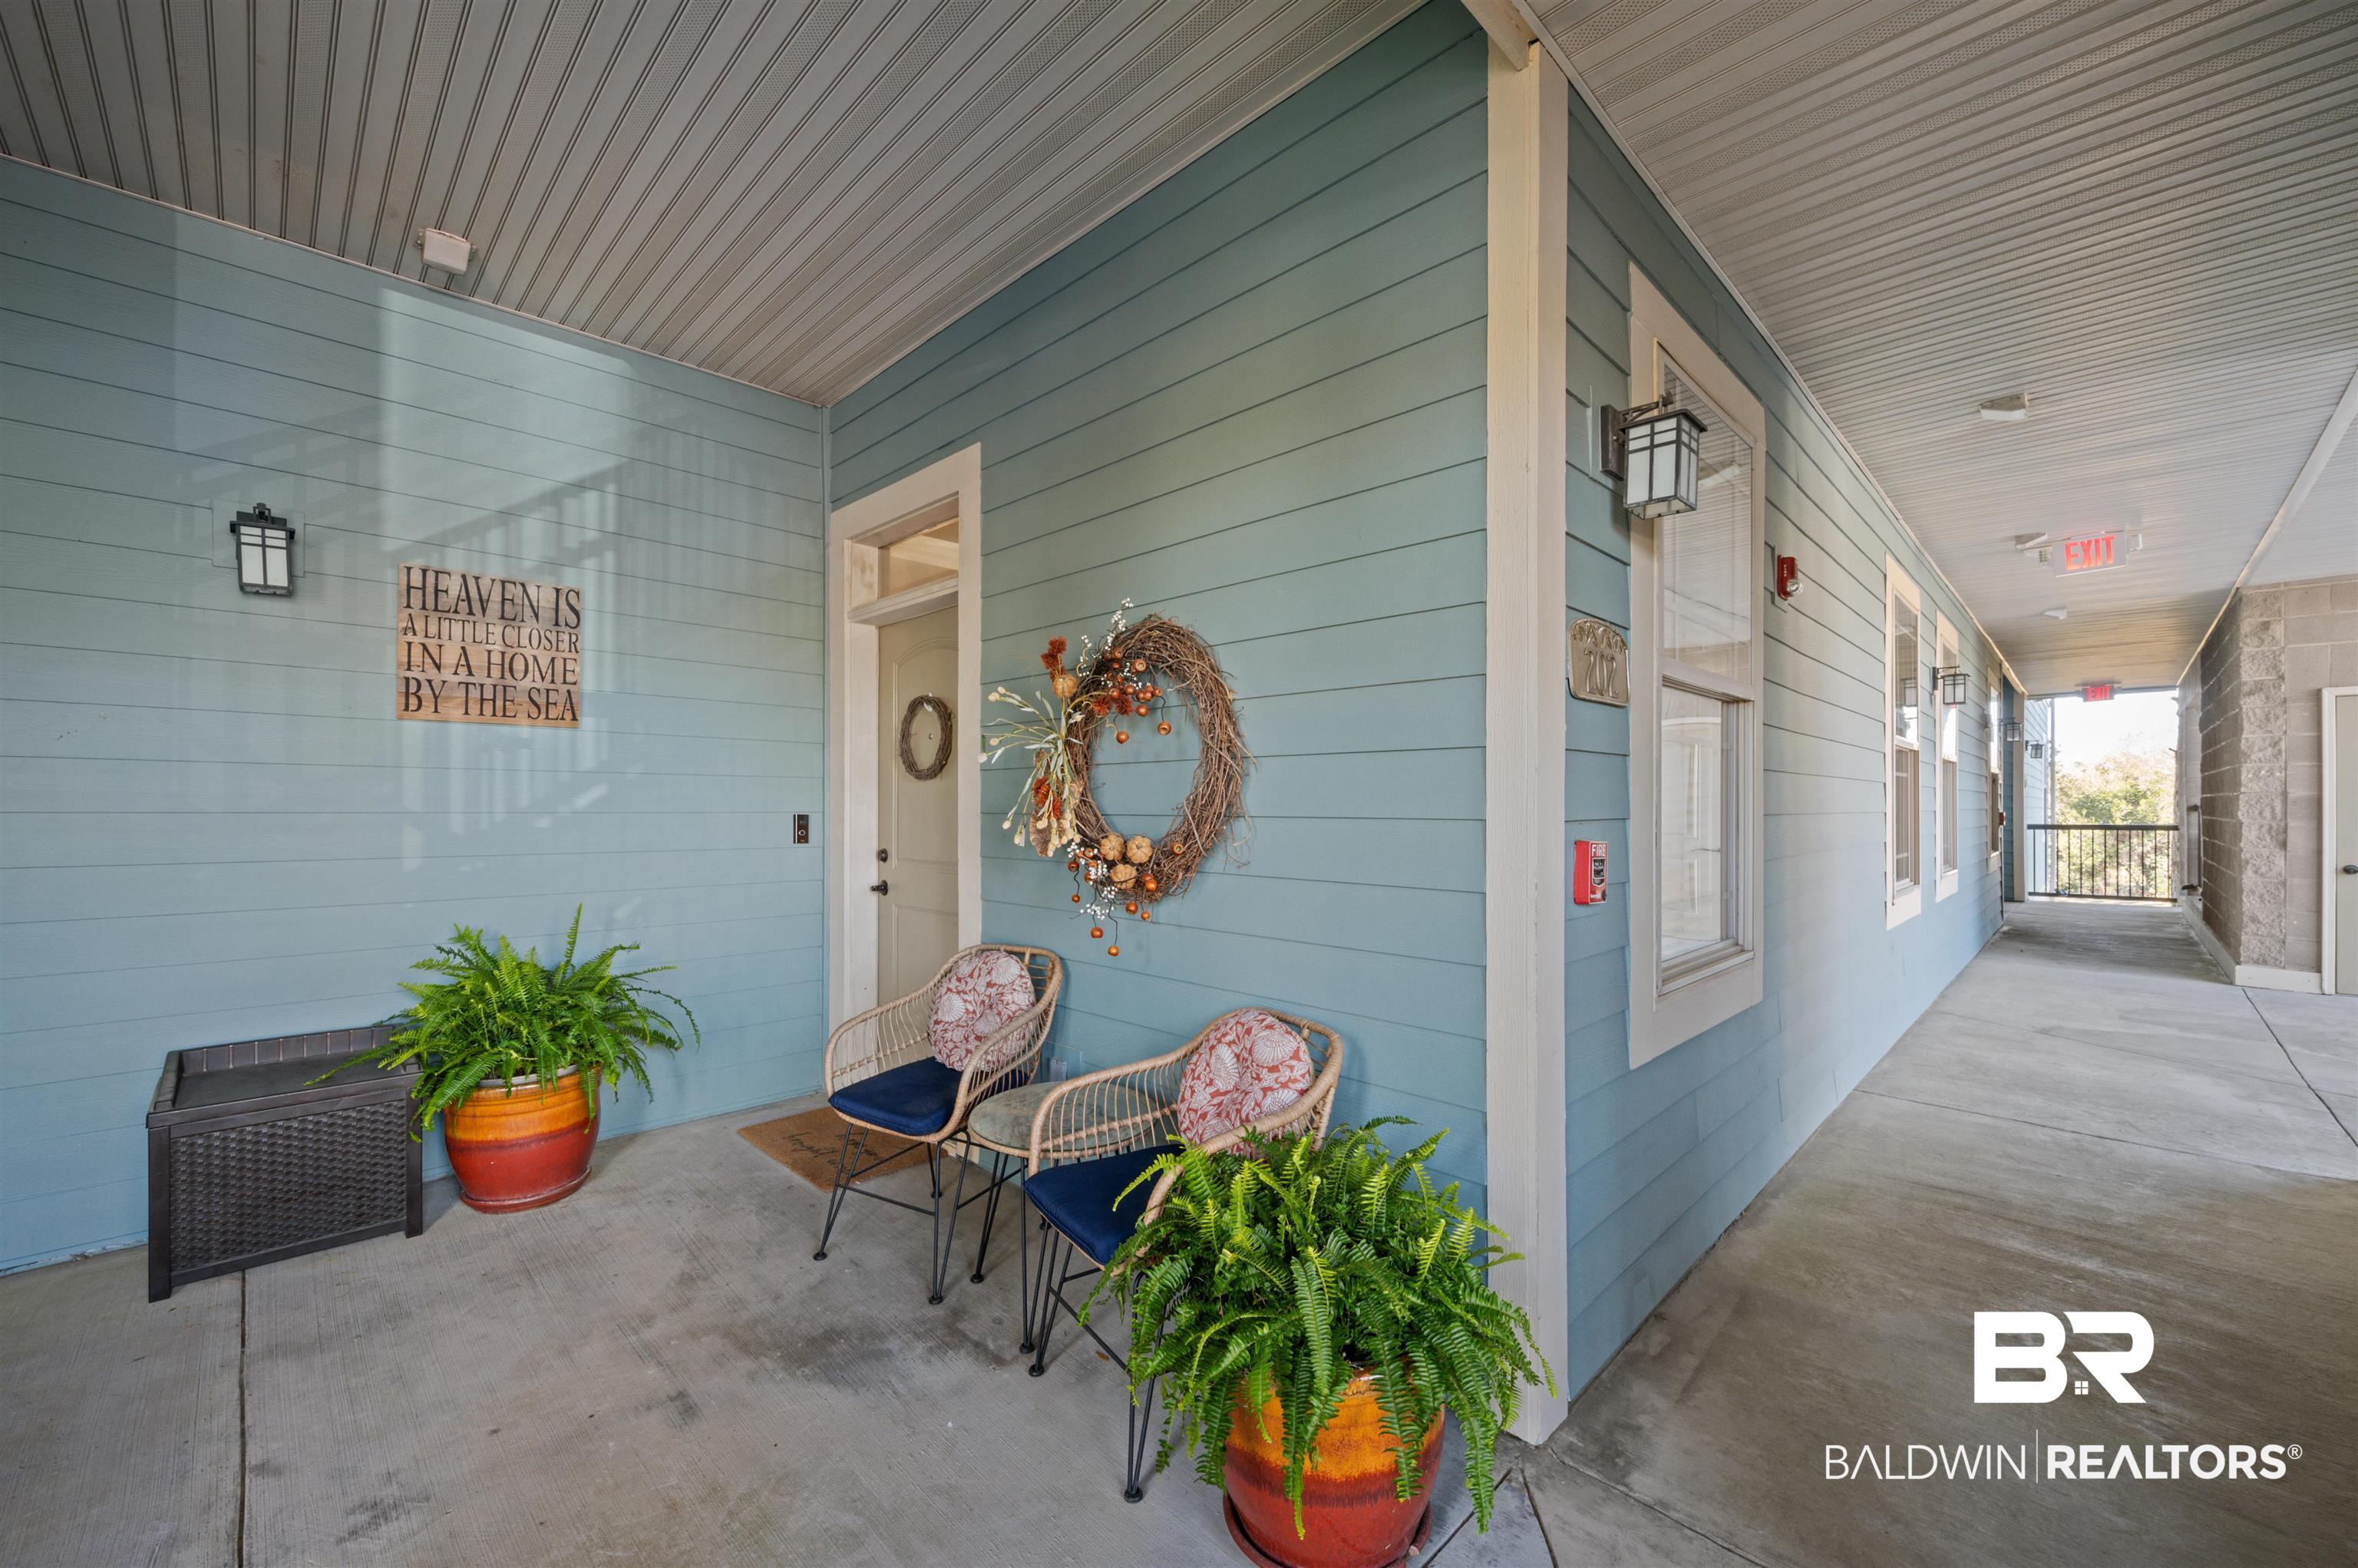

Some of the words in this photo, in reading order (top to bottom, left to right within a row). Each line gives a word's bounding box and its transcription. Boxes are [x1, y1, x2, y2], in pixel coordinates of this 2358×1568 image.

[2065, 535, 2116, 571] EXIT
[403, 566, 542, 624] HEAVEN
[552, 587, 580, 629] IS
[403, 613, 418, 636] A
[424, 616, 497, 645] LITTLE
[501, 624, 580, 654] CLOSER
[405, 641, 444, 674] IN
[452, 646, 475, 677] A
[486, 649, 577, 685] HOME
[1584, 647, 1620, 698] 202
[402, 676, 447, 714] BY
[457, 682, 517, 718] THE
[528, 687, 578, 721] SEA
[2087, 686, 2111, 701] EXIT
[1591, 843, 1607, 857] FIRE
